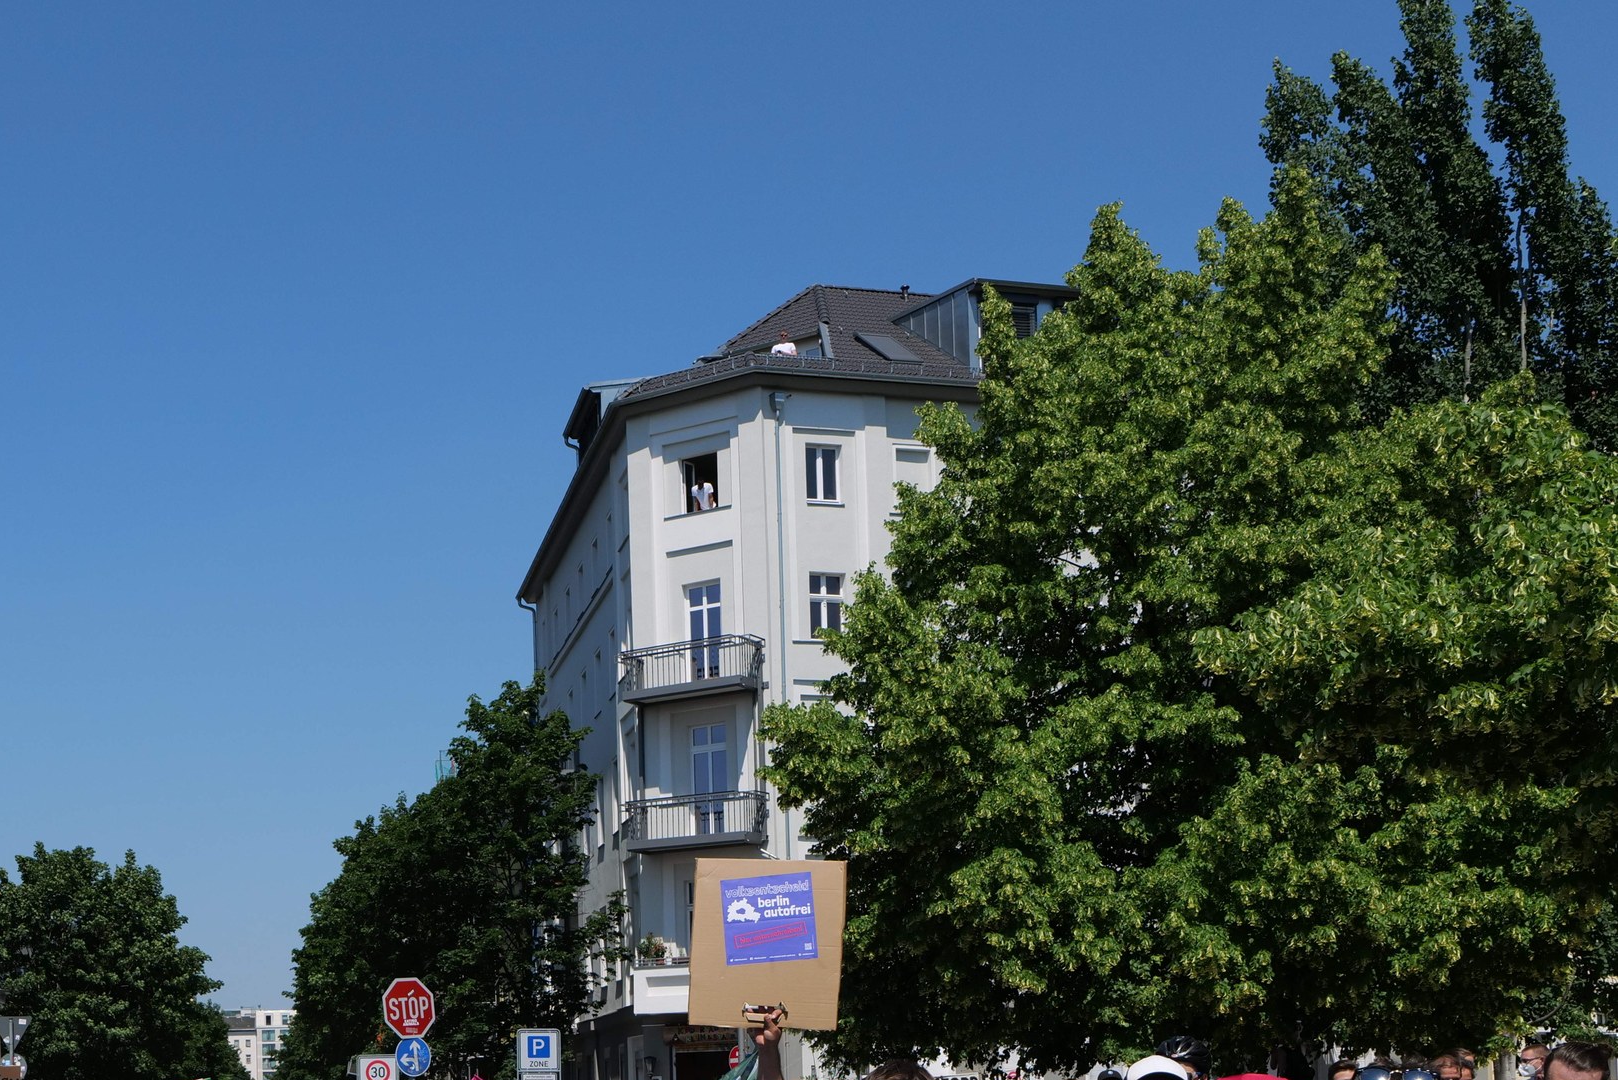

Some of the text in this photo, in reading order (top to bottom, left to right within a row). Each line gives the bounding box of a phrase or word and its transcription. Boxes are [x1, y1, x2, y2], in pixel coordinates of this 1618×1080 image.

[757, 895, 790, 908] berlin
[763, 903, 812, 918] autofrei
[388, 996, 429, 1021] STOP
[532, 1038, 545, 1056] P
[370, 1066, 386, 1078] 30
